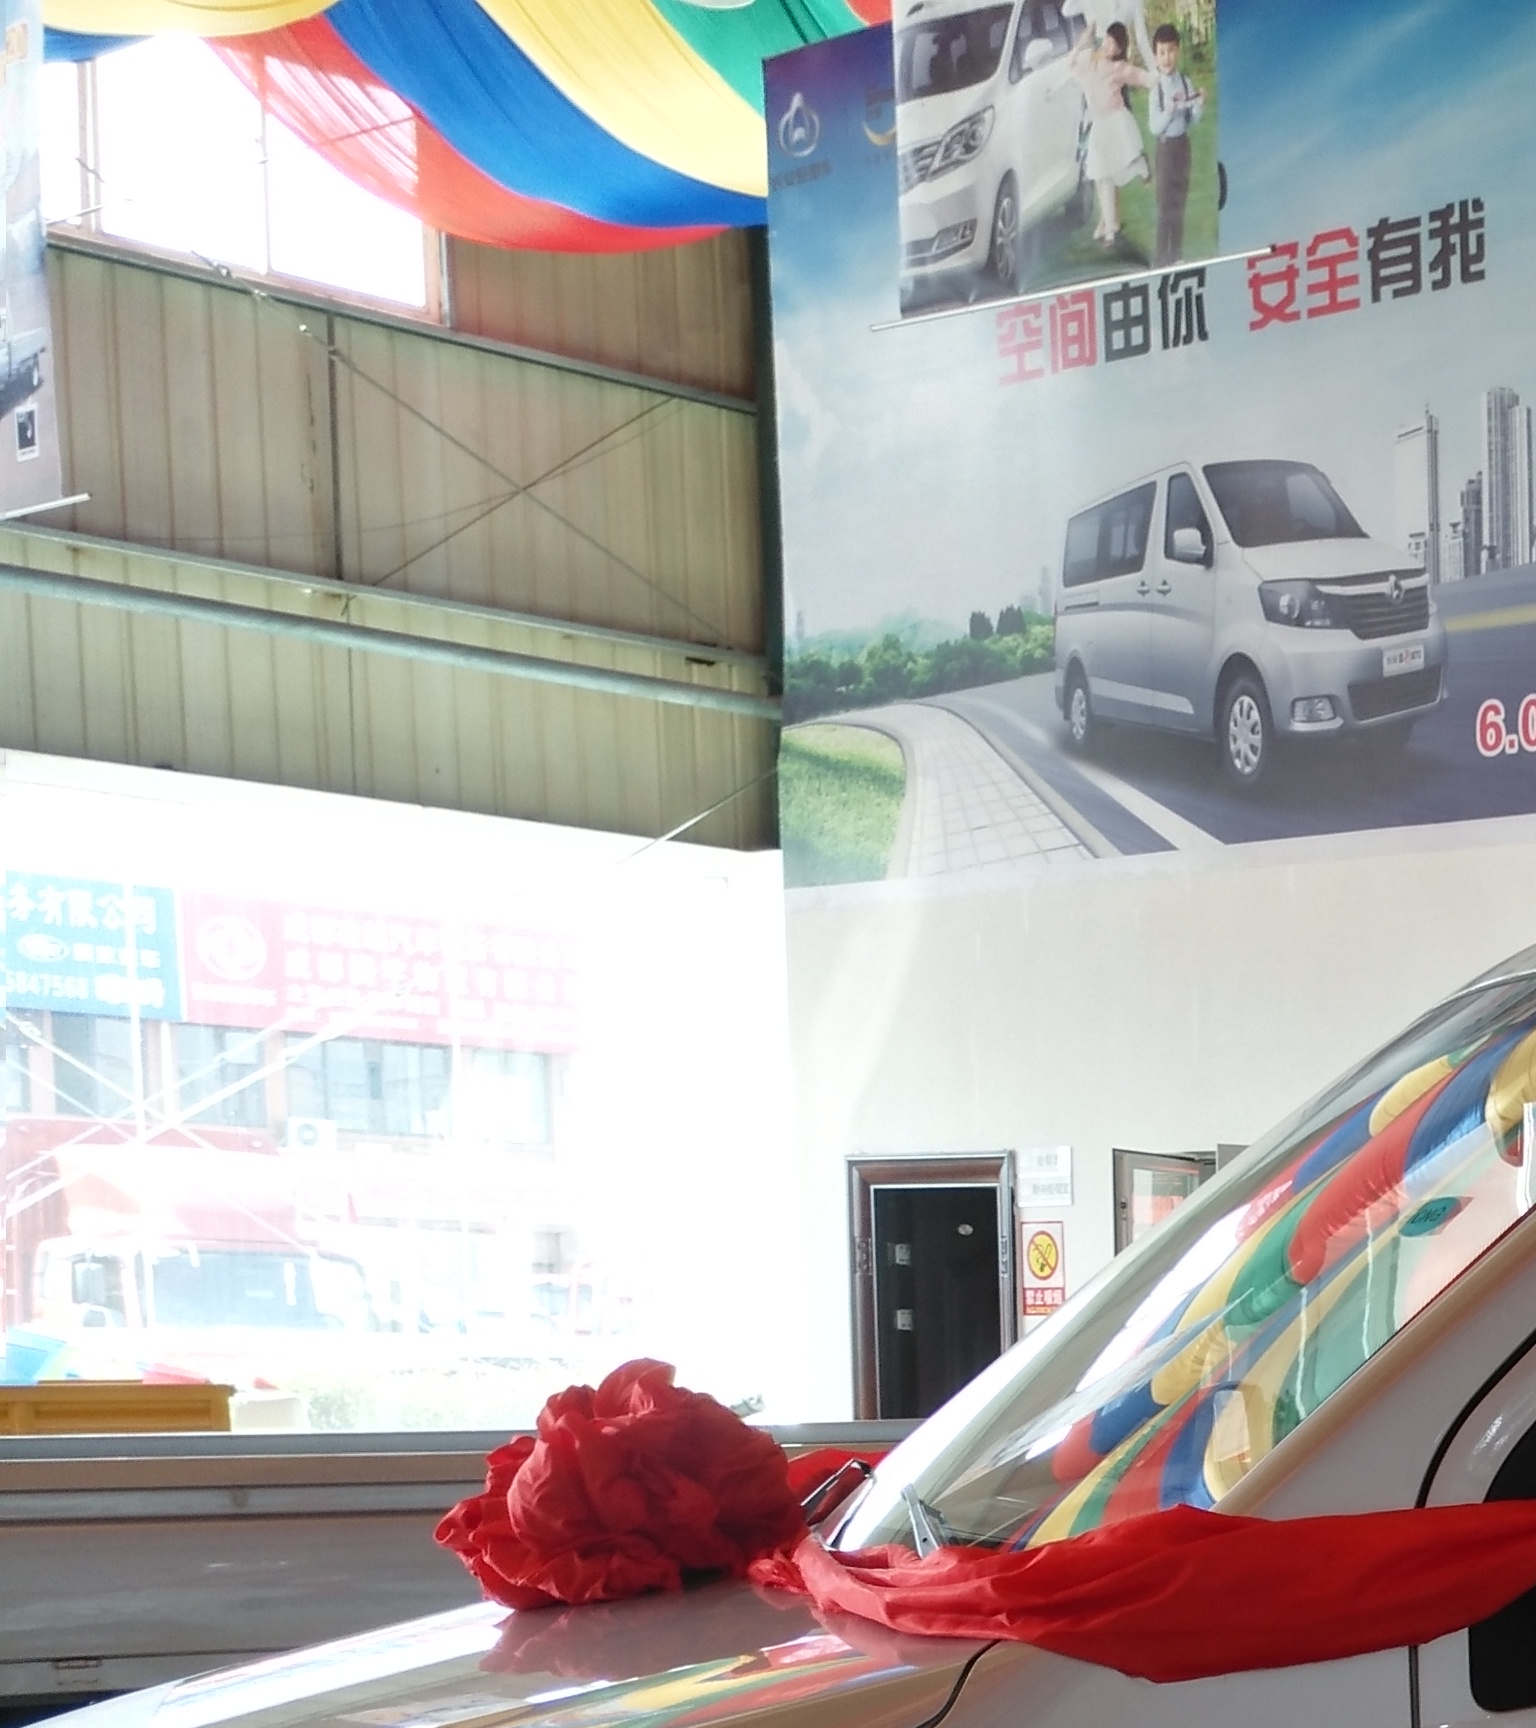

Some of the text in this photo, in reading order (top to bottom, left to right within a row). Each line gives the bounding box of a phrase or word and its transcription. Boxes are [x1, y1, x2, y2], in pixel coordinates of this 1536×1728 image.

[995, 197, 1486, 387] 空间由你 安全有我
